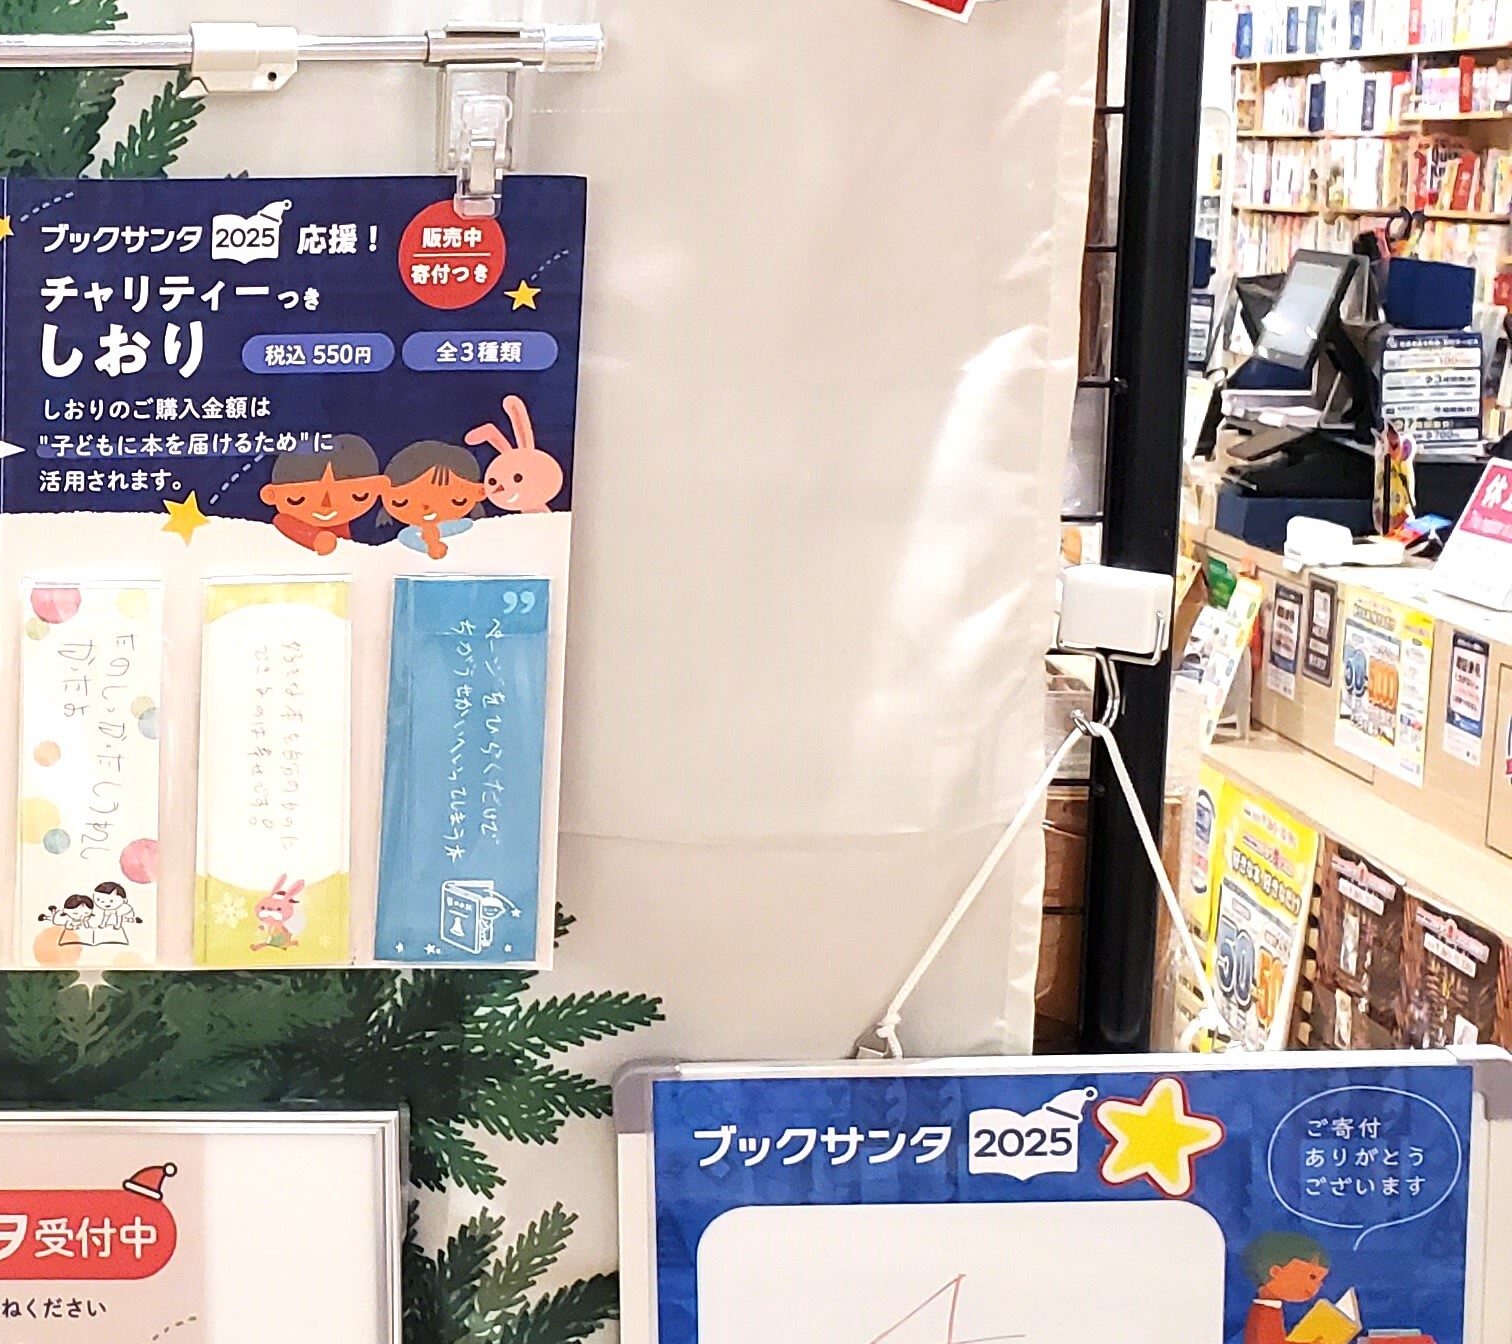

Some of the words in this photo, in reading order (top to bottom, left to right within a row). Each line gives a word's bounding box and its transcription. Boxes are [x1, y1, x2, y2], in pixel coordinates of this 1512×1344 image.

[41, 223, 203, 255] ブックサンタ
[215, 228, 275, 248] 2025
[422, 227, 482, 248] 販売中
[411, 263, 488, 285] 寄付つき
[41, 275, 320, 313] チャリティーつき
[42, 320, 204, 378] しおり
[264, 344, 307, 365] 税込
[313, 344, 372, 365] 550円
[436, 341, 522, 363] 全3種類
[43, 396, 271, 421] しおりのご購入金額は
[38, 468, 184, 492] 活用されます。
[1305, 1115, 1384, 1138] ご寄付
[692, 1120, 953, 1169] ブックサンタ
[973, 1128, 1073, 1159] 2025
[1303, 1145, 1426, 1168] ありがとう
[1303, 1175, 1428, 1198] ございます
